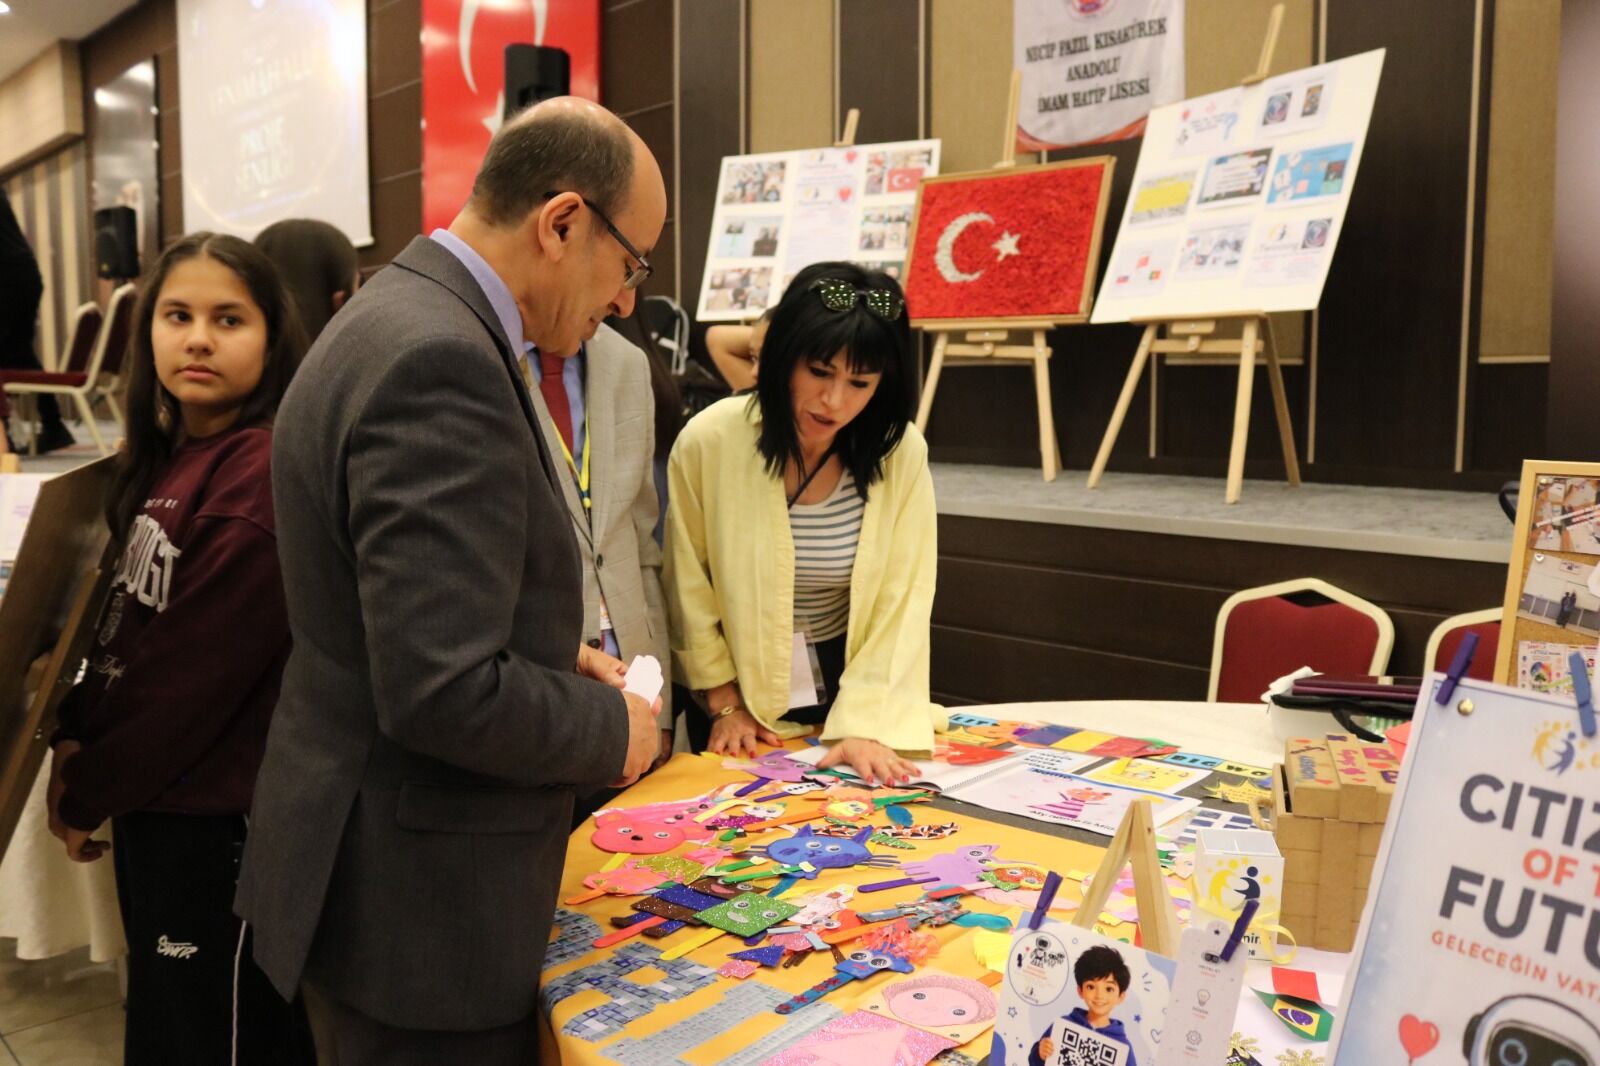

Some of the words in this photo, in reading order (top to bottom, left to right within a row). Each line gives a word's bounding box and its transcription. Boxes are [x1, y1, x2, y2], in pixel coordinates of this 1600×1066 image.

[1059, 36, 1091, 57] FAZIL
[1094, 18, 1167, 50] KISAKÜREK
[1066, 56, 1121, 82] ANADOLU
[1072, 85, 1106, 108] HATİP
[1109, 73, 1150, 101] LİSESİ
[1170, 755, 1216, 767] BIG
[1226, 764, 1268, 776] WO
[1522, 848, 1579, 886] OF
[1431, 930, 1547, 982] GELECEĞİN
[1557, 972, 1600, 1002] VAT
